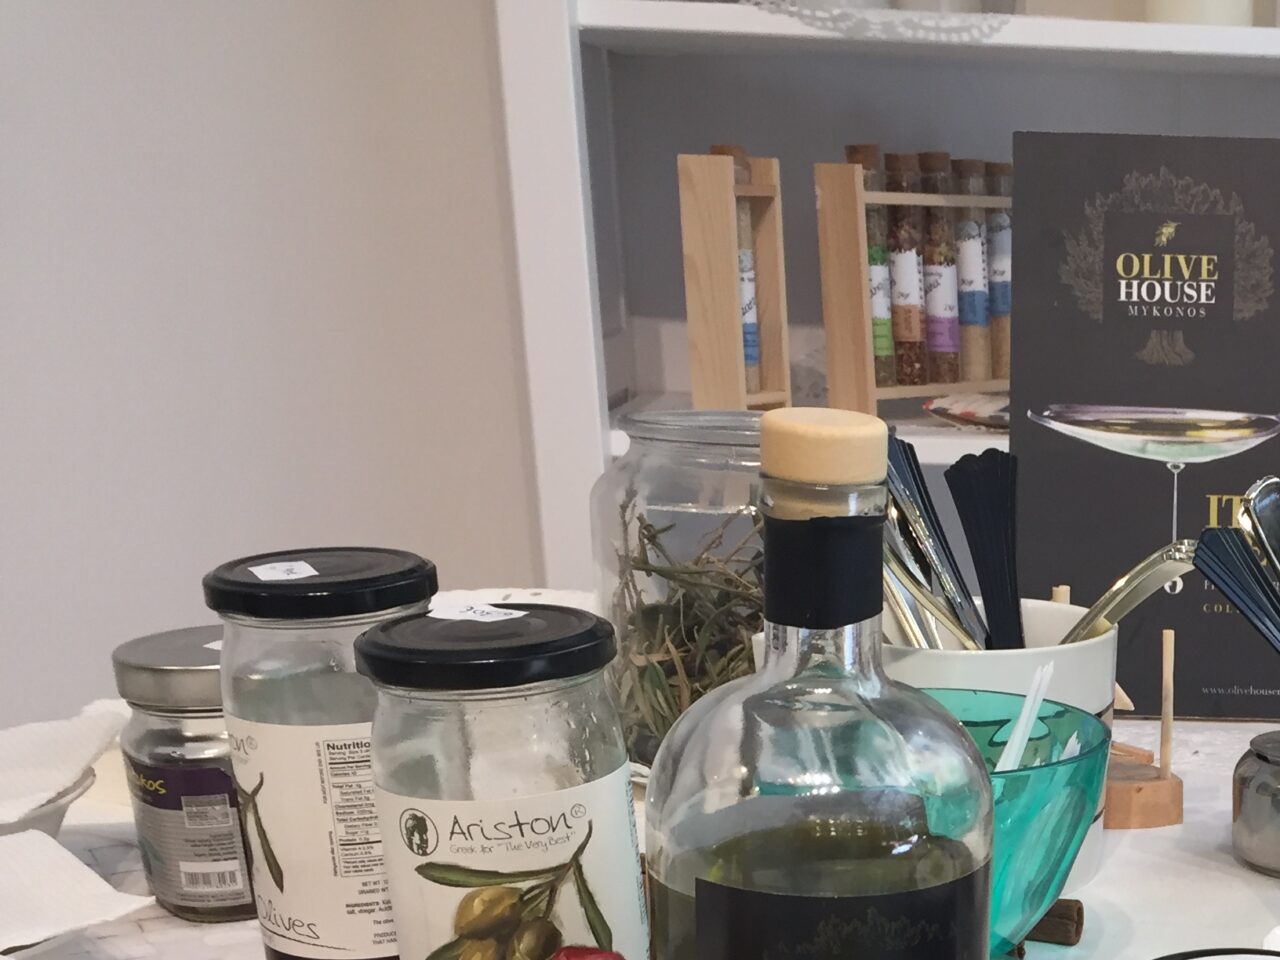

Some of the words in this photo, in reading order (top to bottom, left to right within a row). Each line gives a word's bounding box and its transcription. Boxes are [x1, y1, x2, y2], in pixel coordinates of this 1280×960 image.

[1116, 253, 1218, 280] OLIVE
[1118, 280, 1215, 303] HOUSE
[1128, 305, 1206, 317] MYKONOS
[1203, 604, 1241, 613] COL
[326, 741, 371, 751] Nutritio
[449, 810, 572, 841] Ariston
